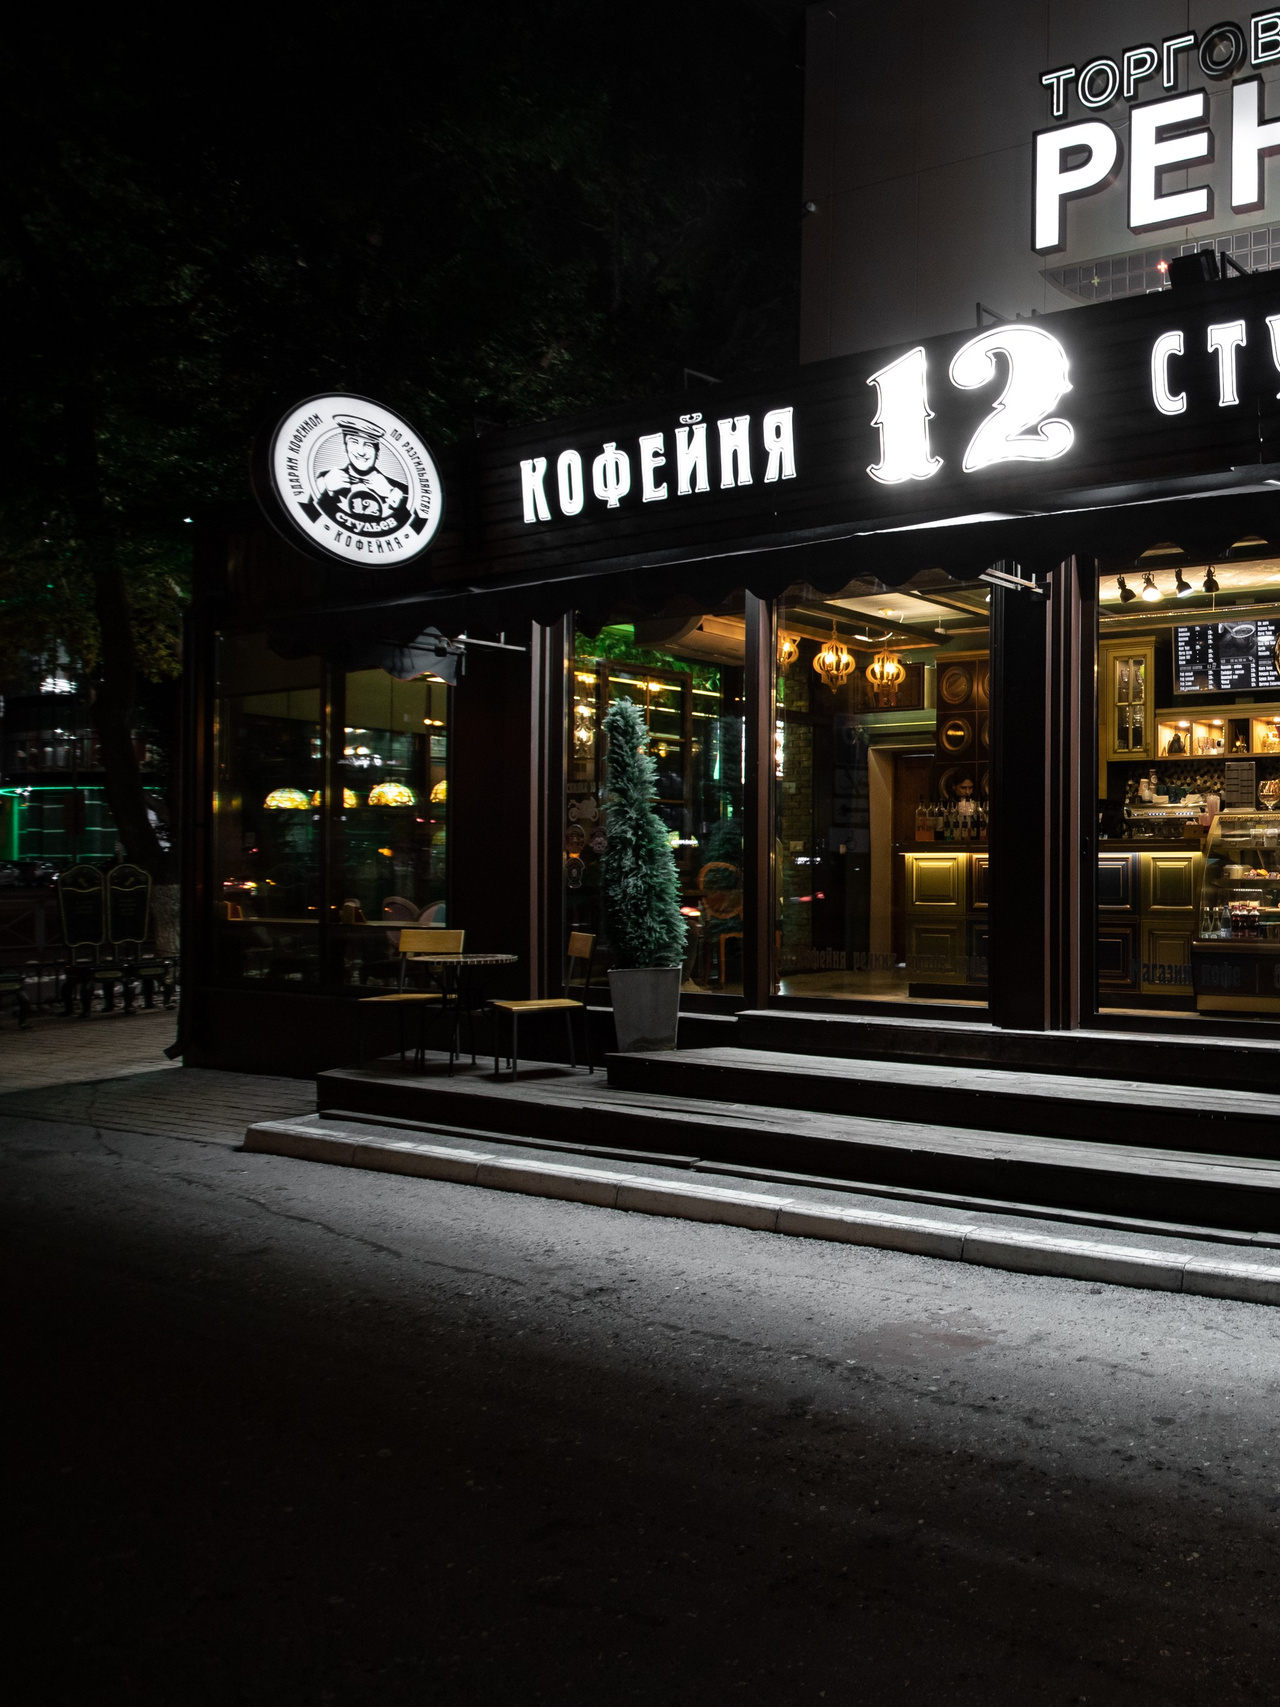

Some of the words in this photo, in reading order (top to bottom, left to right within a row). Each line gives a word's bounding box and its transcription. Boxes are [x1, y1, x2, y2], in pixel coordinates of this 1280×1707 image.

[287, 412, 324, 455] КОФЕИНОМ
[519, 406, 798, 524] КОФЕЙНЯ
[865, 323, 1076, 486] 12
[286, 456, 305, 497] УДАРИМ
[390, 428, 403, 442] ПО
[402, 441, 432, 515] РАЗГИЛЬДЯЙСТВУ
[351, 497, 381, 516] 12
[333, 529, 404, 554] КОФЕЙНЯ
[1200, 961, 1241, 989] кофе
